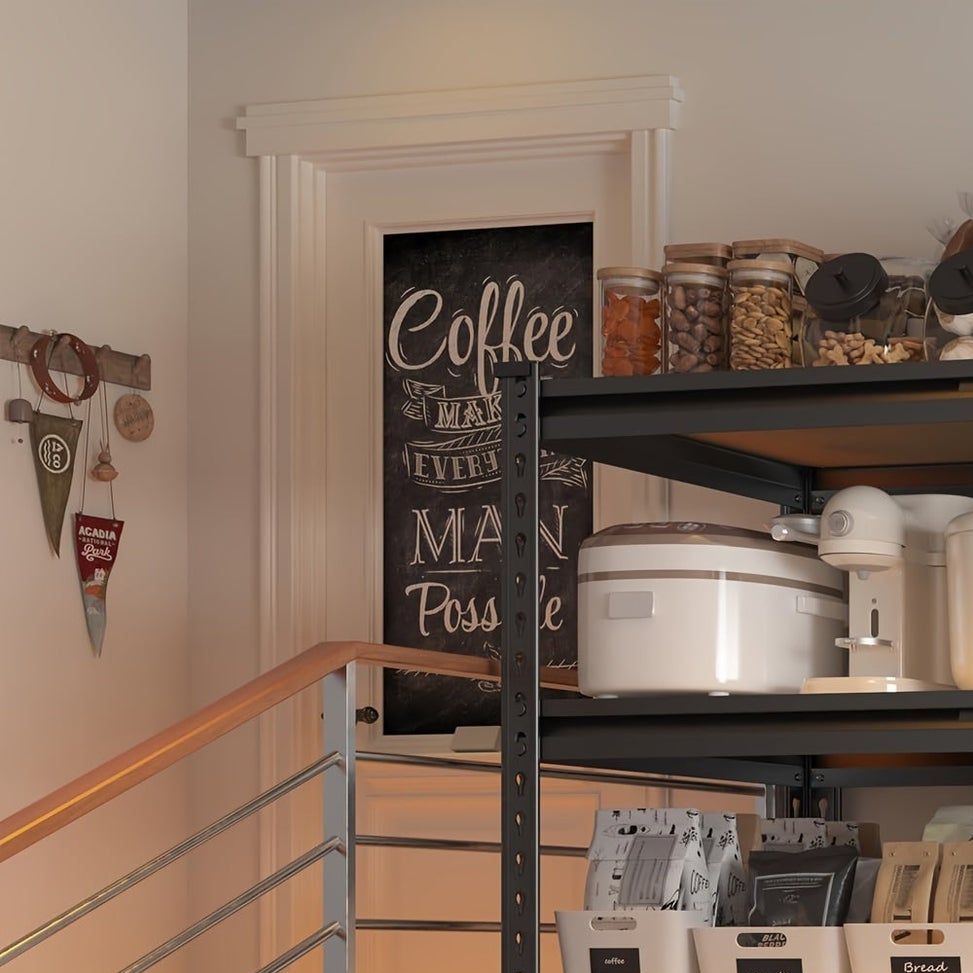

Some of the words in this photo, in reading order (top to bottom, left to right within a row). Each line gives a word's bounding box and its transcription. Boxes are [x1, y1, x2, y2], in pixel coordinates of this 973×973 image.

[388, 280, 576, 398] Coffee
[434, 396, 502, 430] MAK
[414, 450, 501, 481] EVERY
[78, 526, 117, 541] ACADIA
[81, 543, 113, 562] Park
[405, 574, 564, 637] Possle
[604, 957, 625, 965] coffee
[903, 961, 948, 973] Bread
